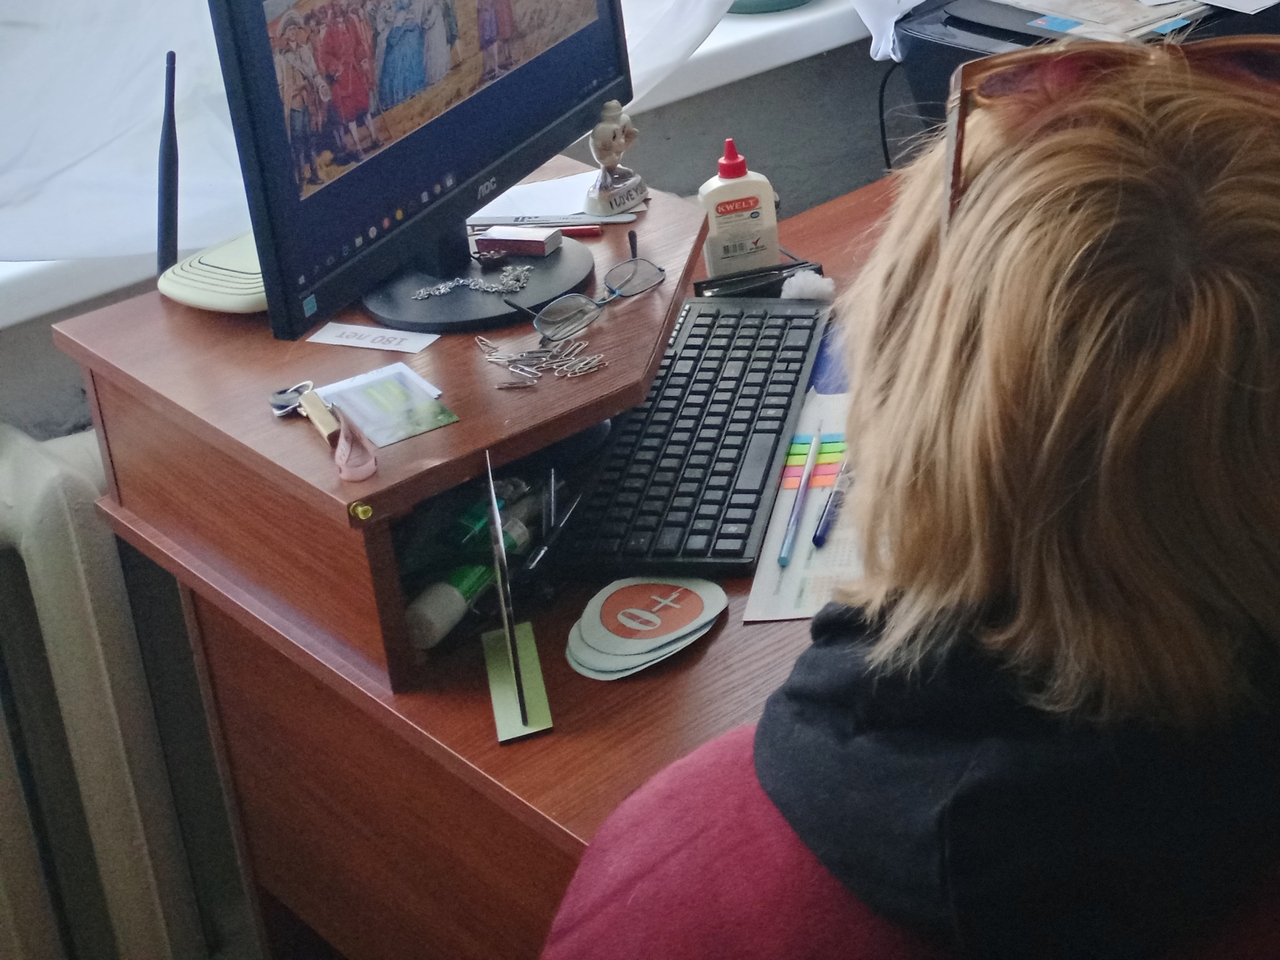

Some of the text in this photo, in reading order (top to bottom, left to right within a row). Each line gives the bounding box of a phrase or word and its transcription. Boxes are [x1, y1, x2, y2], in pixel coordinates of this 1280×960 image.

[477, 176, 497, 200] AOC
[613, 190, 635, 208] LOVE
[717, 199, 756, 213] KWELT
[335, 331, 409, 346] 180 лет
[617, 592, 682, 630] 0+
